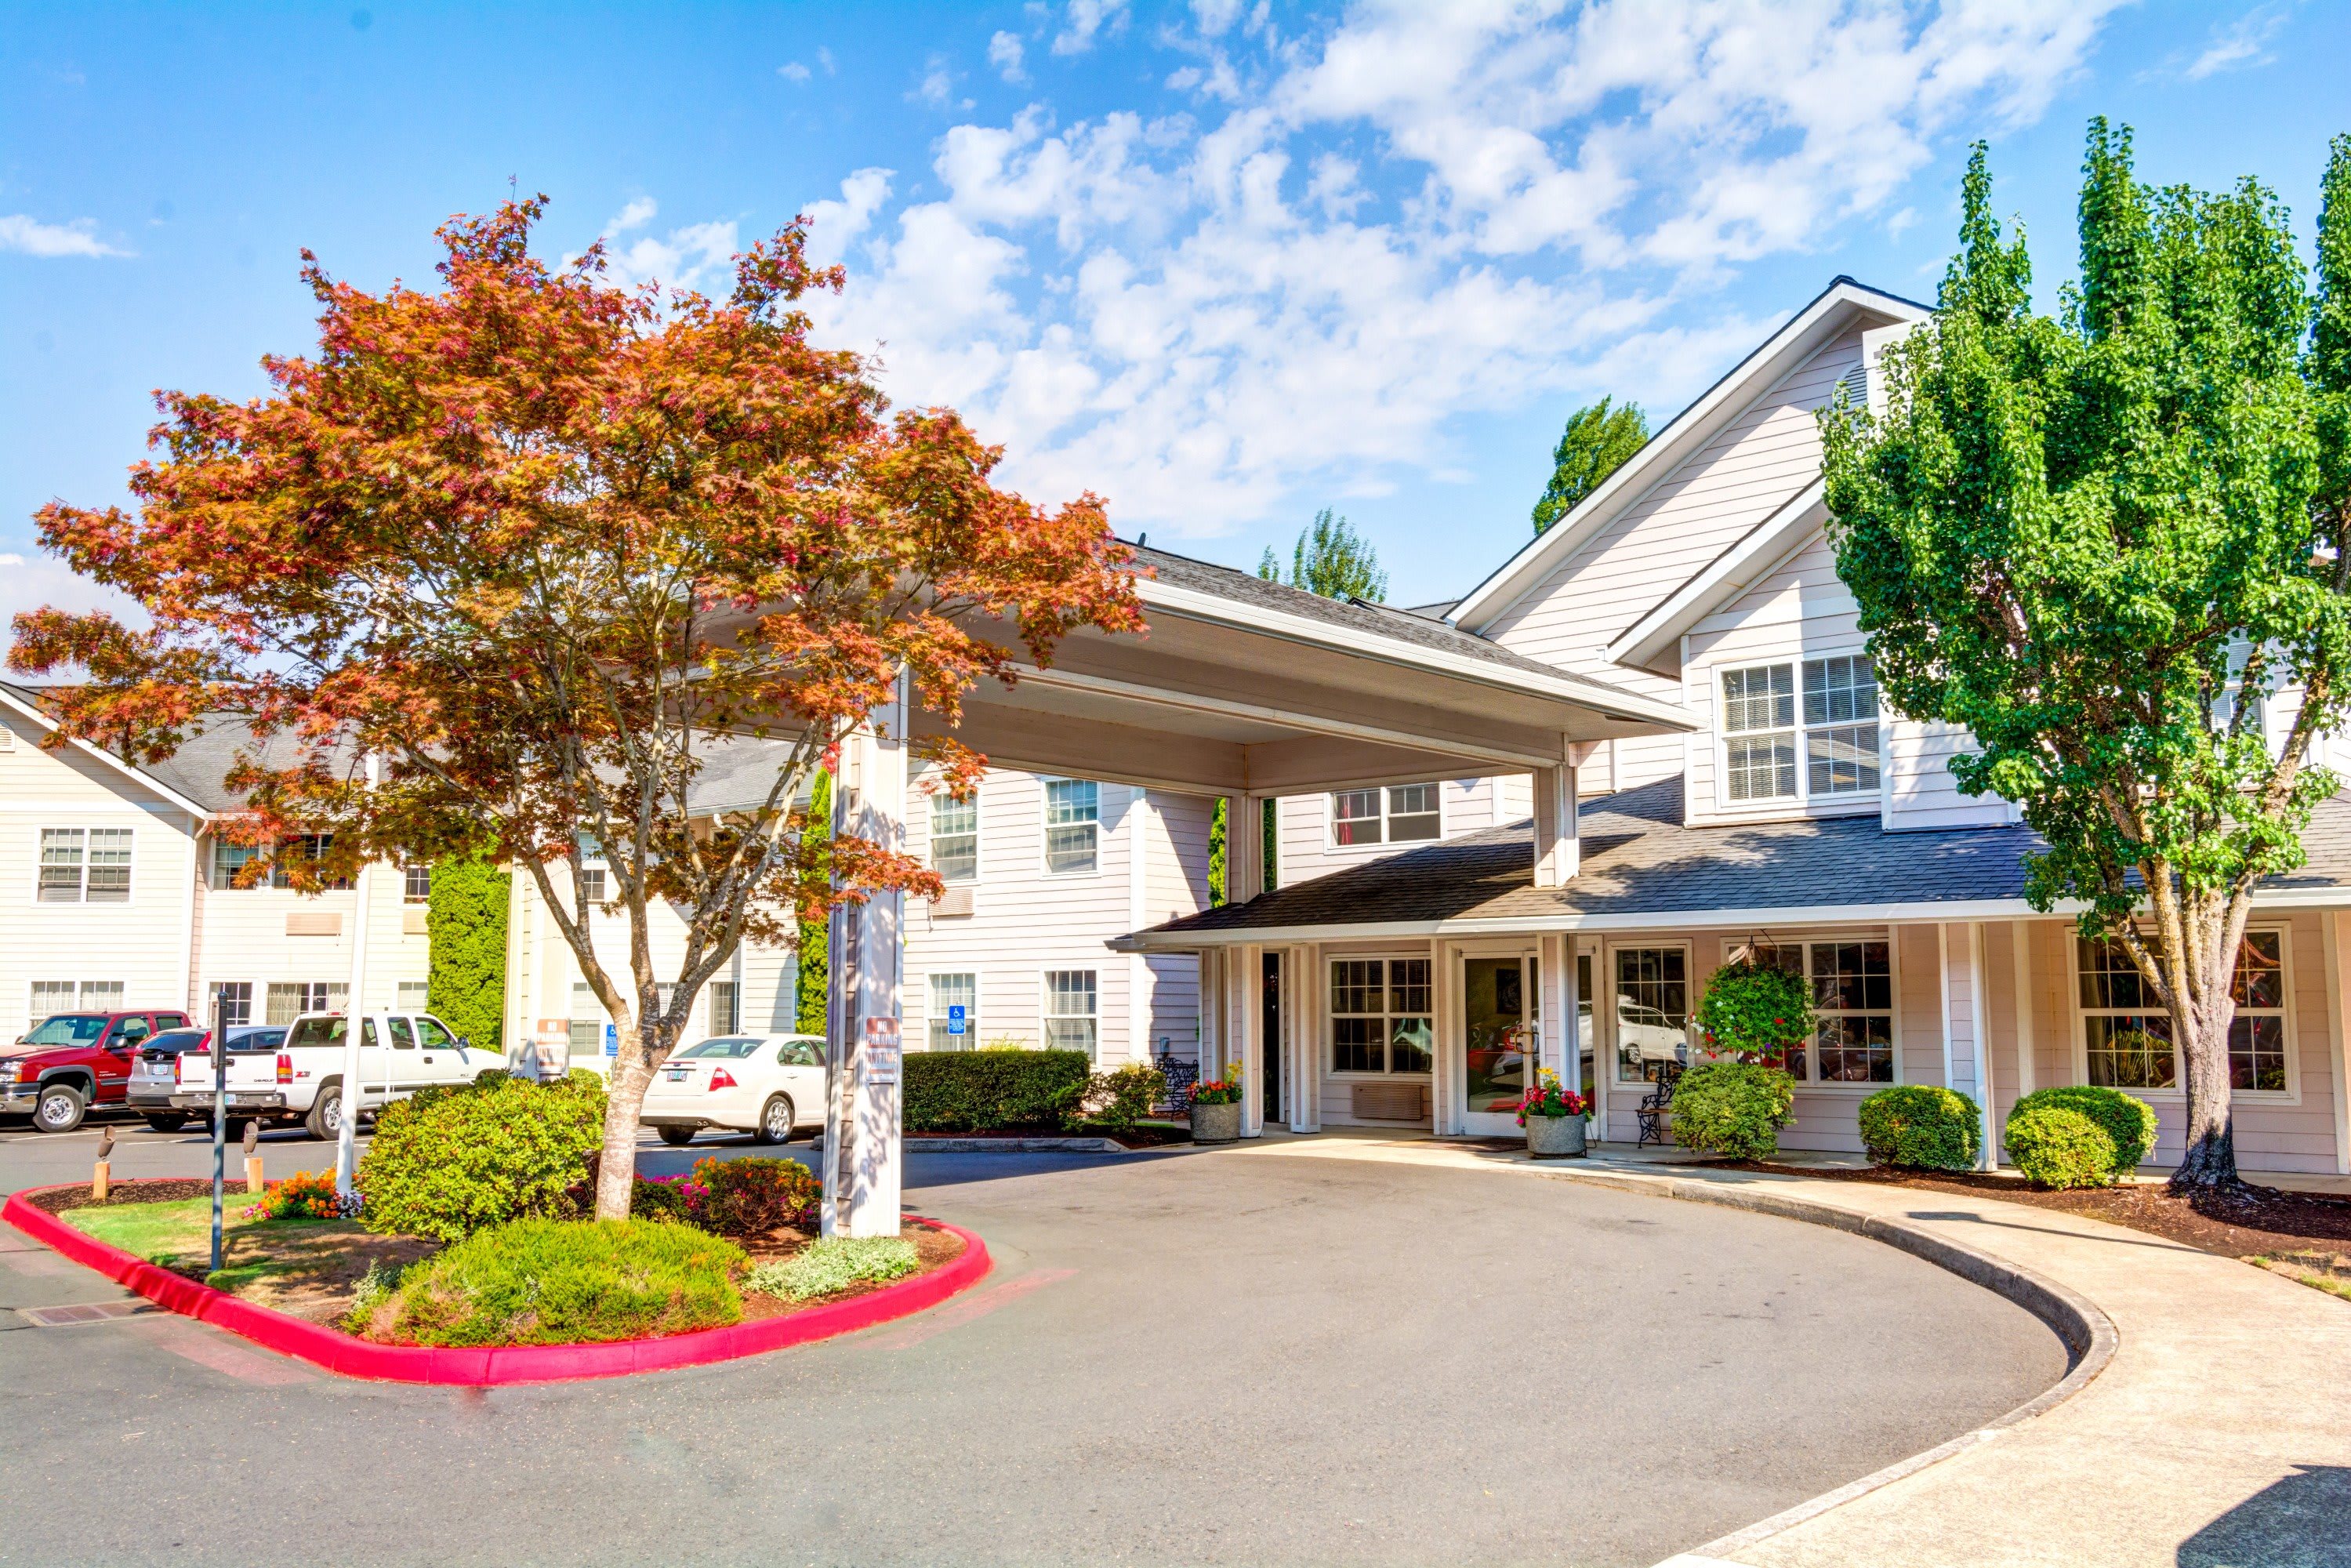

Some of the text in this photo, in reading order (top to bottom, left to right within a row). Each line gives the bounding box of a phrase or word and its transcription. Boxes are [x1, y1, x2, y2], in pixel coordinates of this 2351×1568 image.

[877, 1021, 887, 1033] NO
[867, 1034, 898, 1045] PARKING
[867, 1052, 898, 1064] ANYTIME
